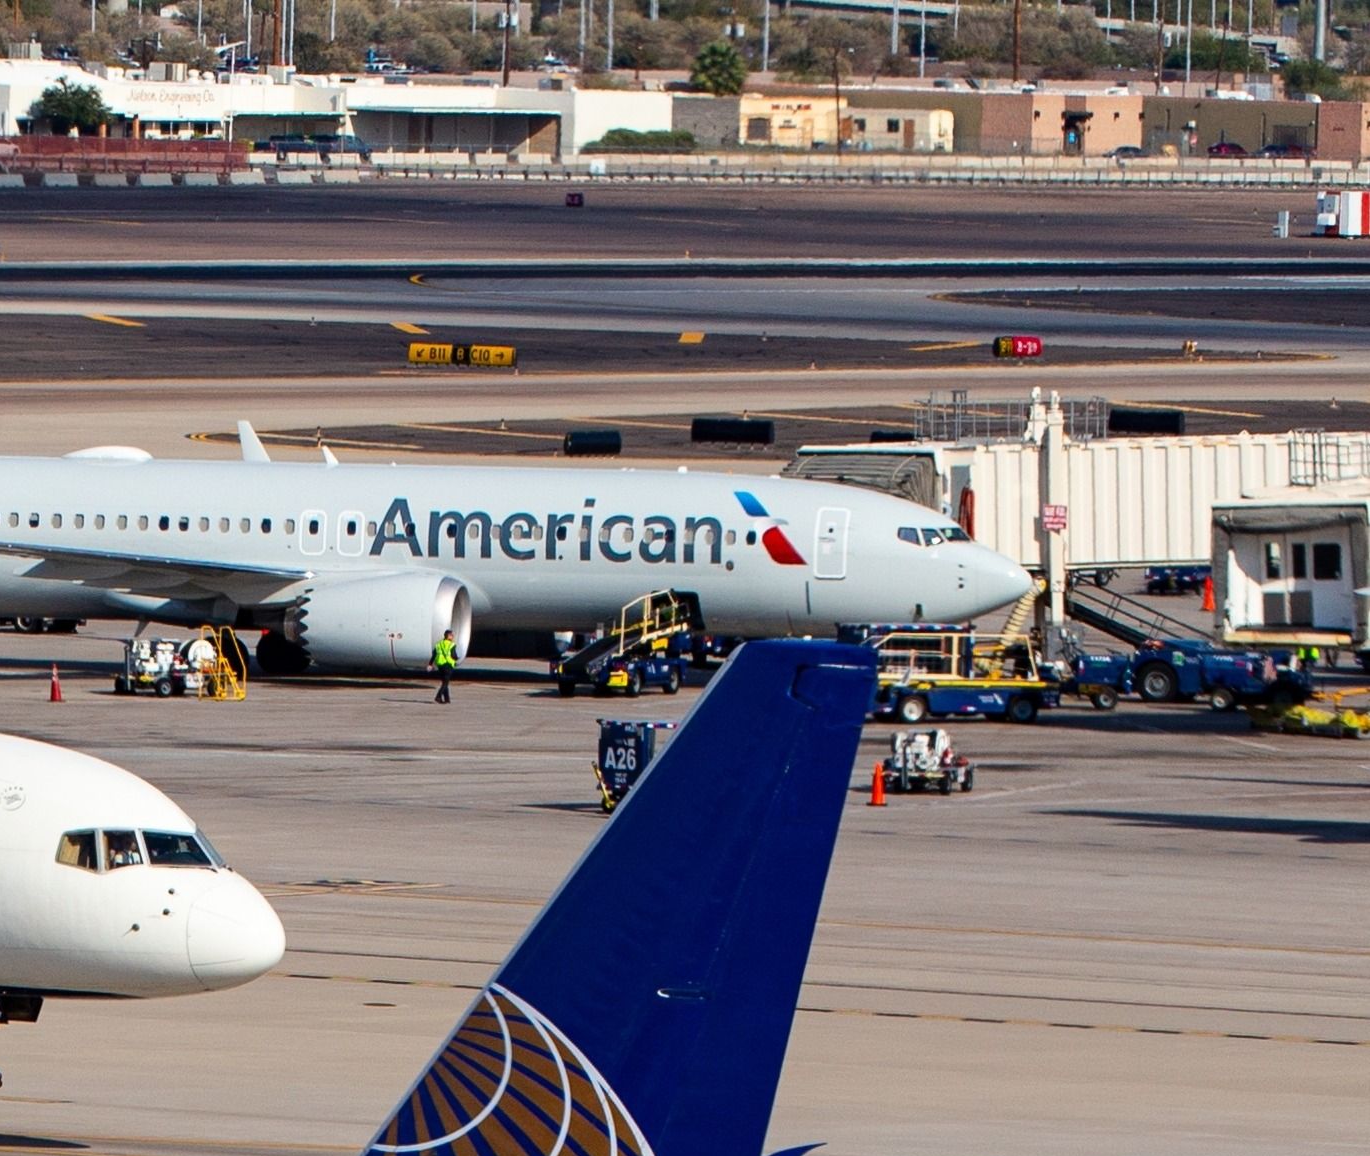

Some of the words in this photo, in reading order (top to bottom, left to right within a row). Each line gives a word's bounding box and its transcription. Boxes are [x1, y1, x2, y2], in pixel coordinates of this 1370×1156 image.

[429, 347, 446, 360] B11
[471, 348, 490, 361] C10
[369, 498, 723, 564] American
[604, 747, 636, 770] A26
